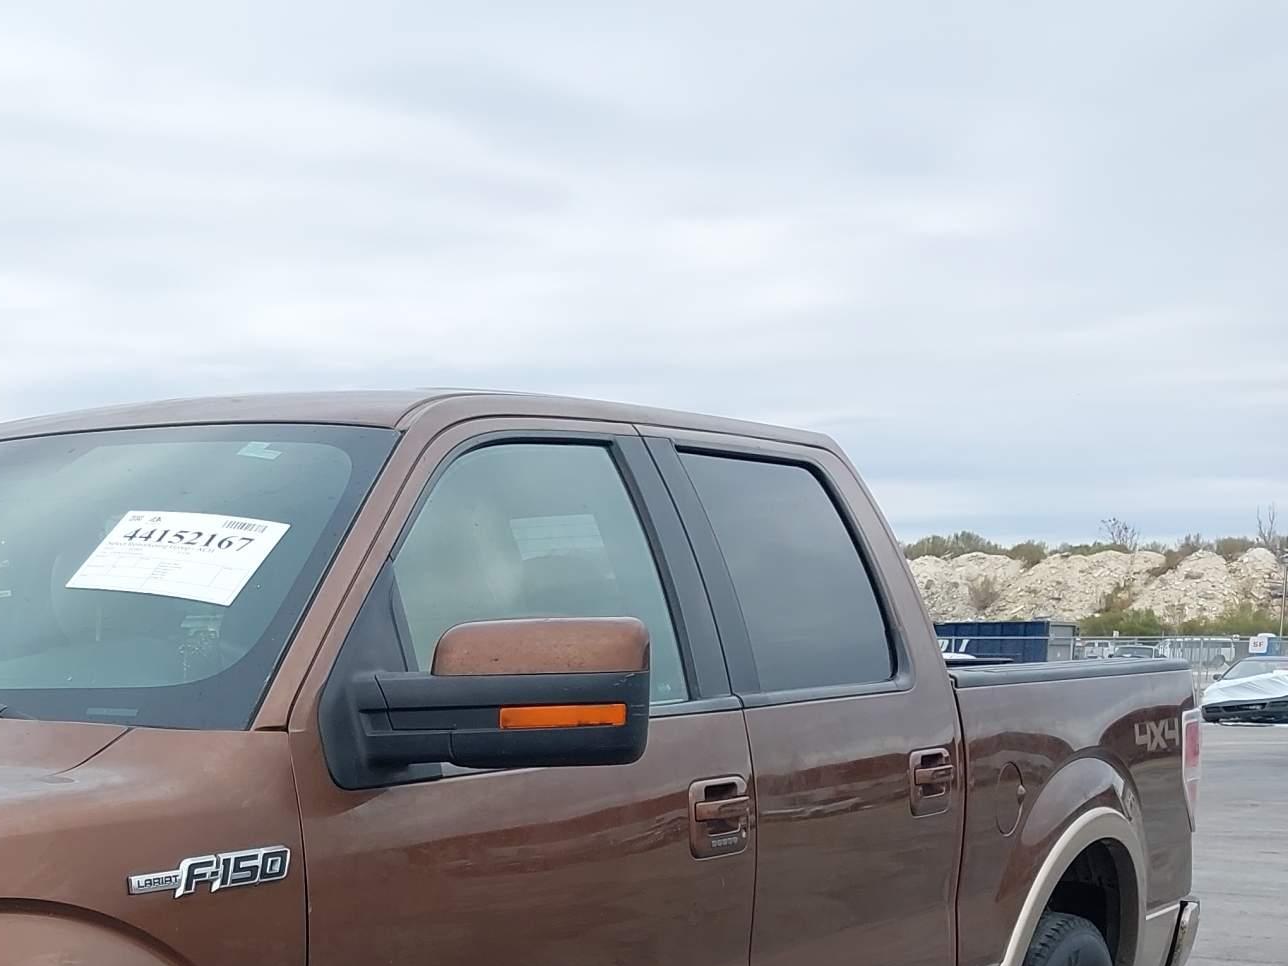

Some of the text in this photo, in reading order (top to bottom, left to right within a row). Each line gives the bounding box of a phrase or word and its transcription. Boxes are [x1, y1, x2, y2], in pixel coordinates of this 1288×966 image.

[123, 527, 255, 551] 44152167
[1134, 717, 1180, 752] 4X4
[137, 874, 180, 889] LARIAT
